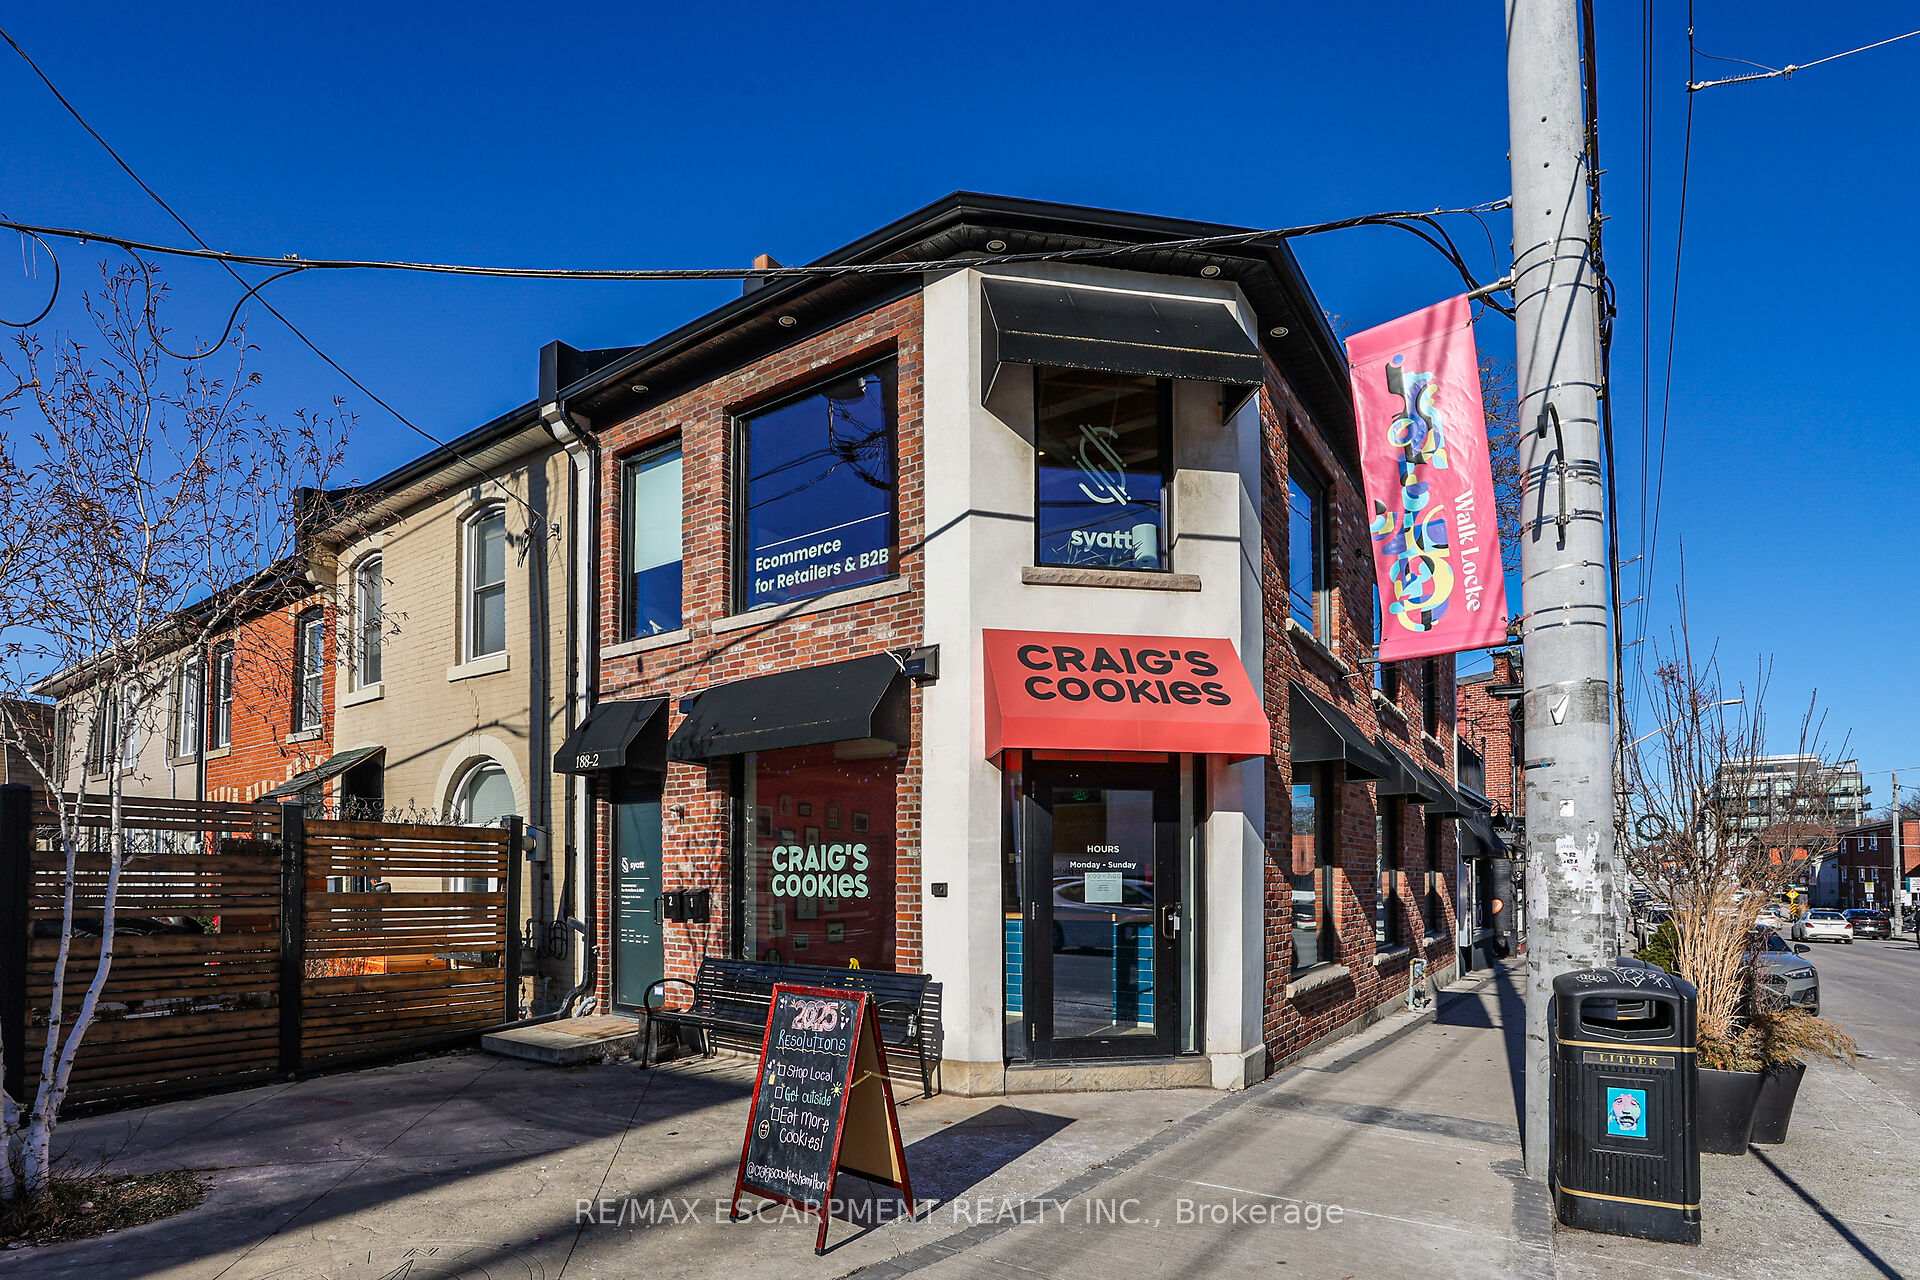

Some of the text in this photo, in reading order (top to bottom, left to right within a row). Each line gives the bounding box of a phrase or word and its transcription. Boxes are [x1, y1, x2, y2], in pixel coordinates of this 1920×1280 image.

[1071, 529, 1133, 552] syatt
[1454, 489, 1485, 611] Walk Locke
[756, 539, 841, 572] Ecommerce
[755, 548, 889, 594] for Retailers & B2B
[1017, 644, 1219, 677] CRAIG'S
[575, 754, 599, 769] 188-2
[771, 844, 869, 871] CRAIG'S
[1086, 845, 1120, 853] HOURS
[1069, 861, 1101, 870] Monday
[1107, 861, 1137, 870] Sunday
[668, 896, 674, 907] 2
[689, 898, 694, 908] 1
[791, 1000, 839, 1032] 2025
[1600, 1054, 1658, 1065] LITTER
[810, 1066, 833, 1082] Local
[784, 1086, 832, 1107] Get outside
[780, 1106, 799, 1126] Eat
